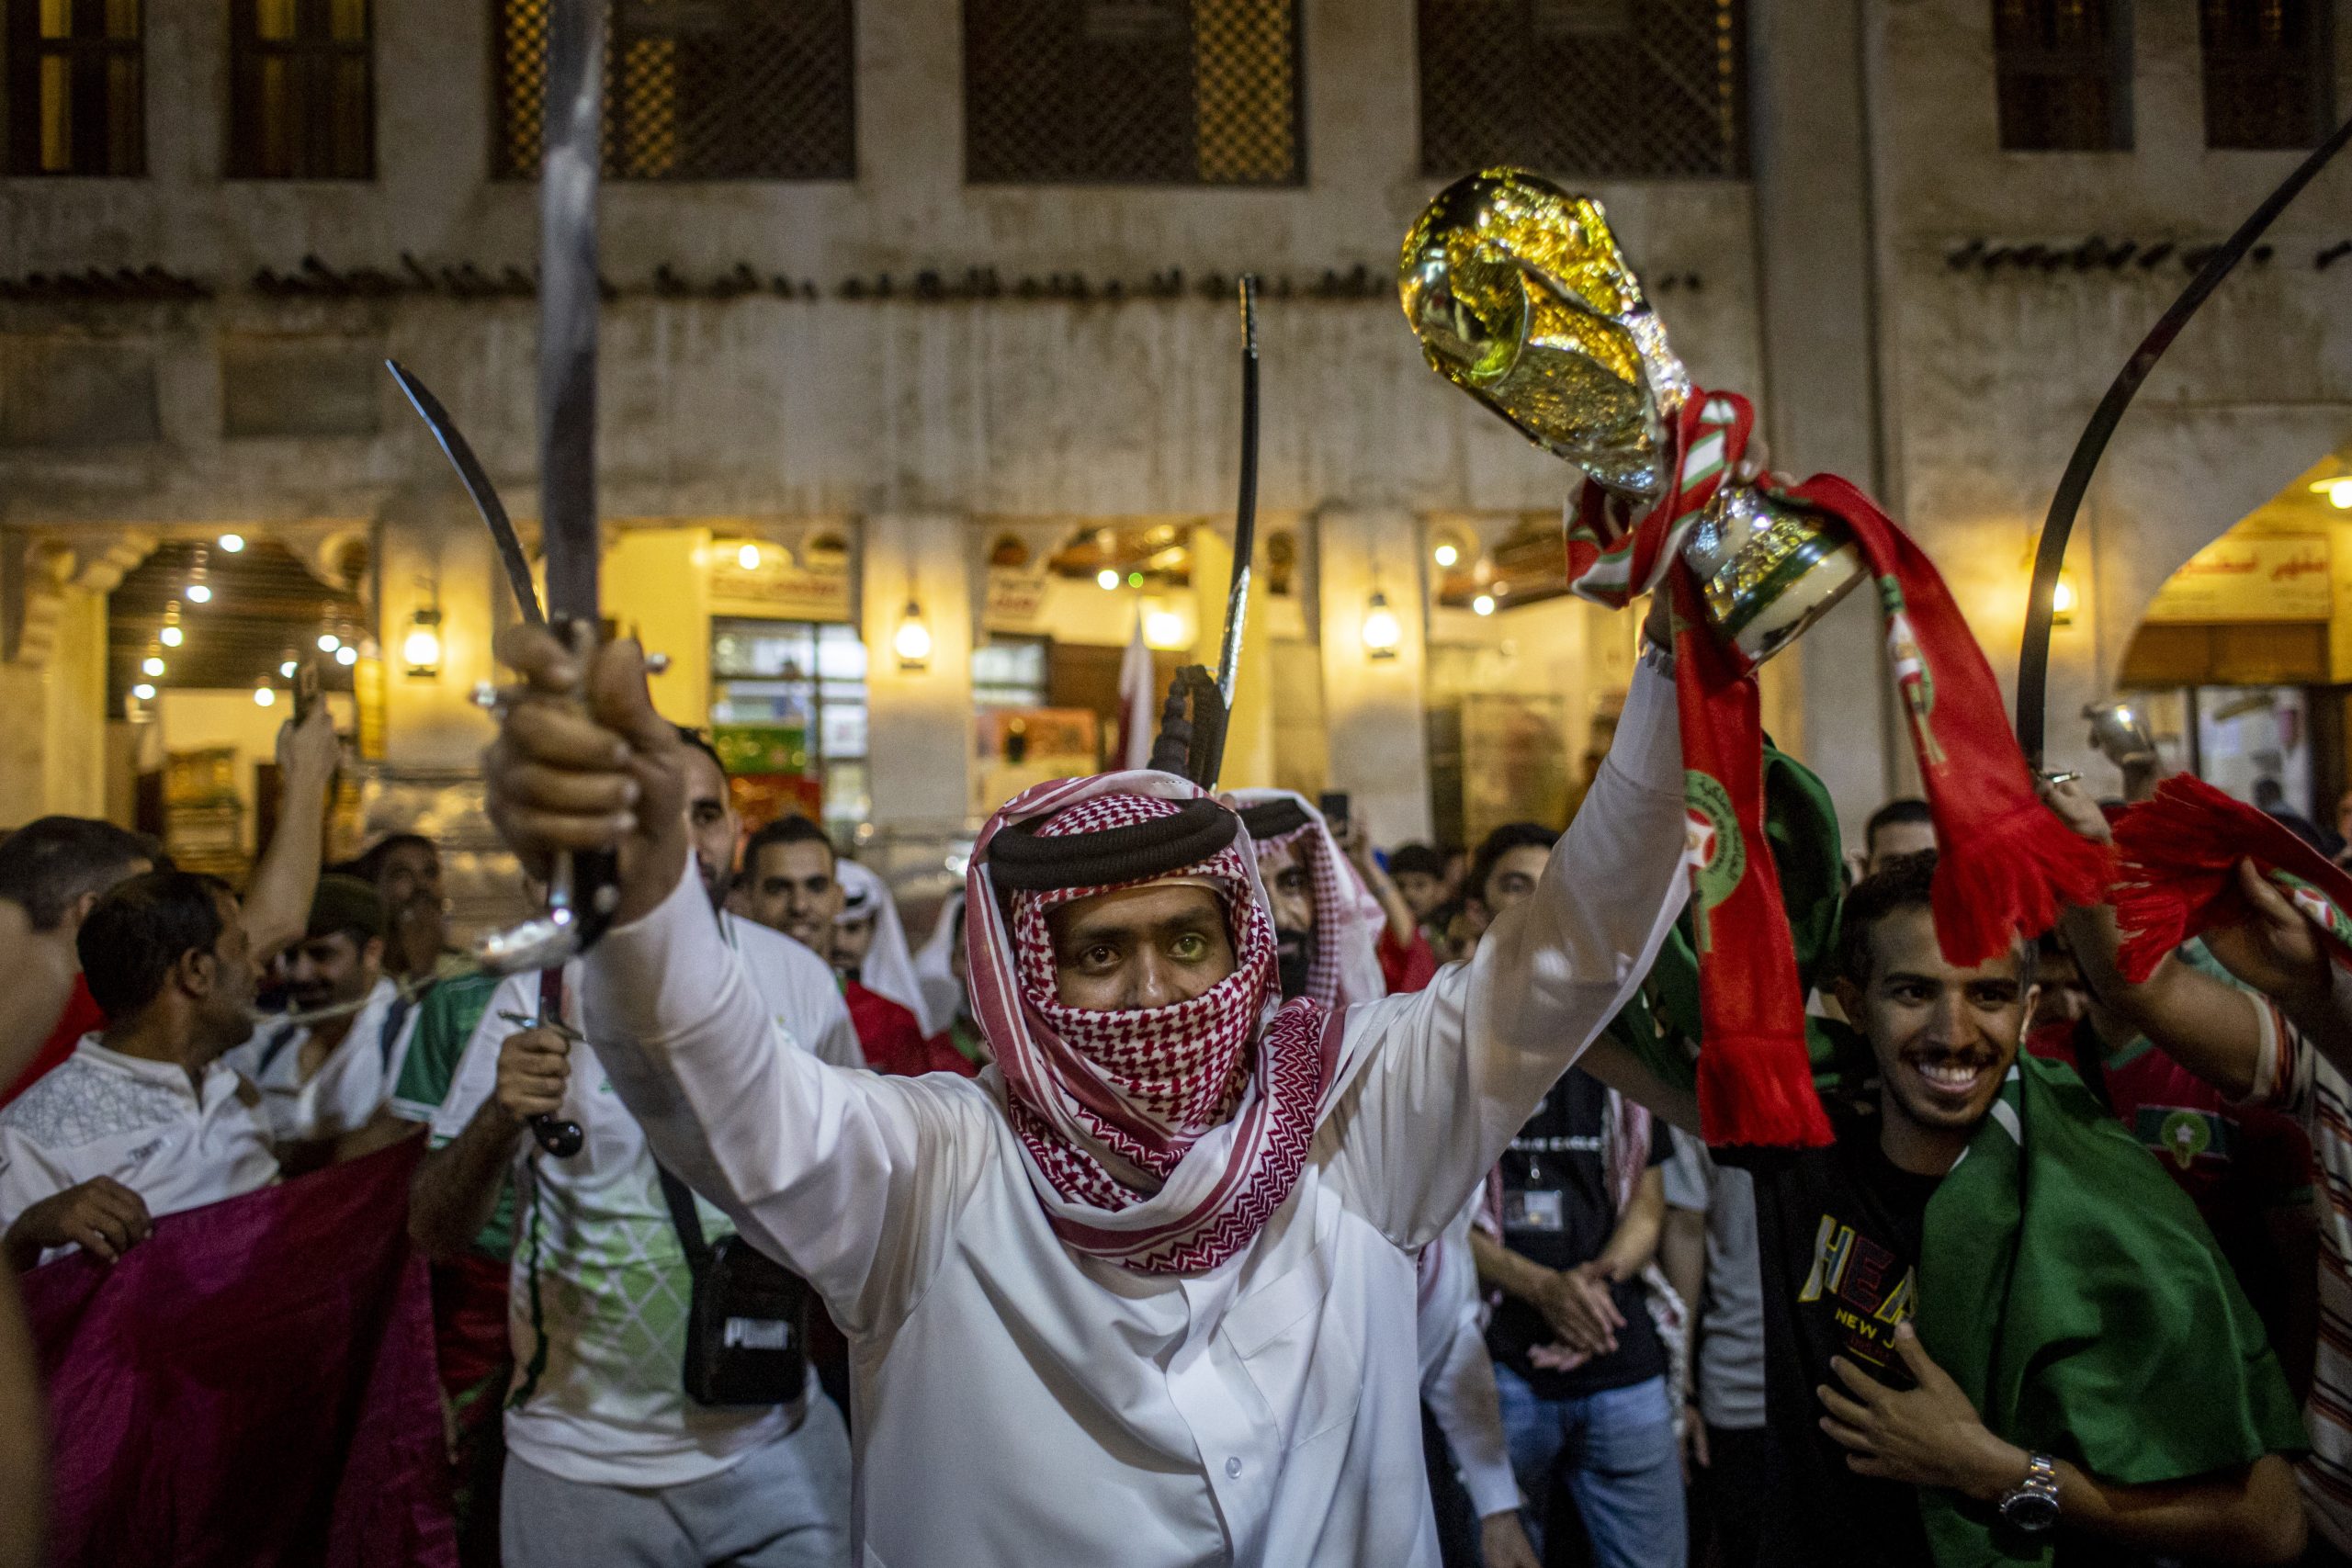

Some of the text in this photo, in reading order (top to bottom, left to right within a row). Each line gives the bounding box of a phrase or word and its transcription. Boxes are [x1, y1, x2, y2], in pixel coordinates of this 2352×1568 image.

[1796, 1213, 1919, 1325] HEA
[724, 1316, 789, 1351] PUMA
[1834, 1307, 1878, 1340] NEW
